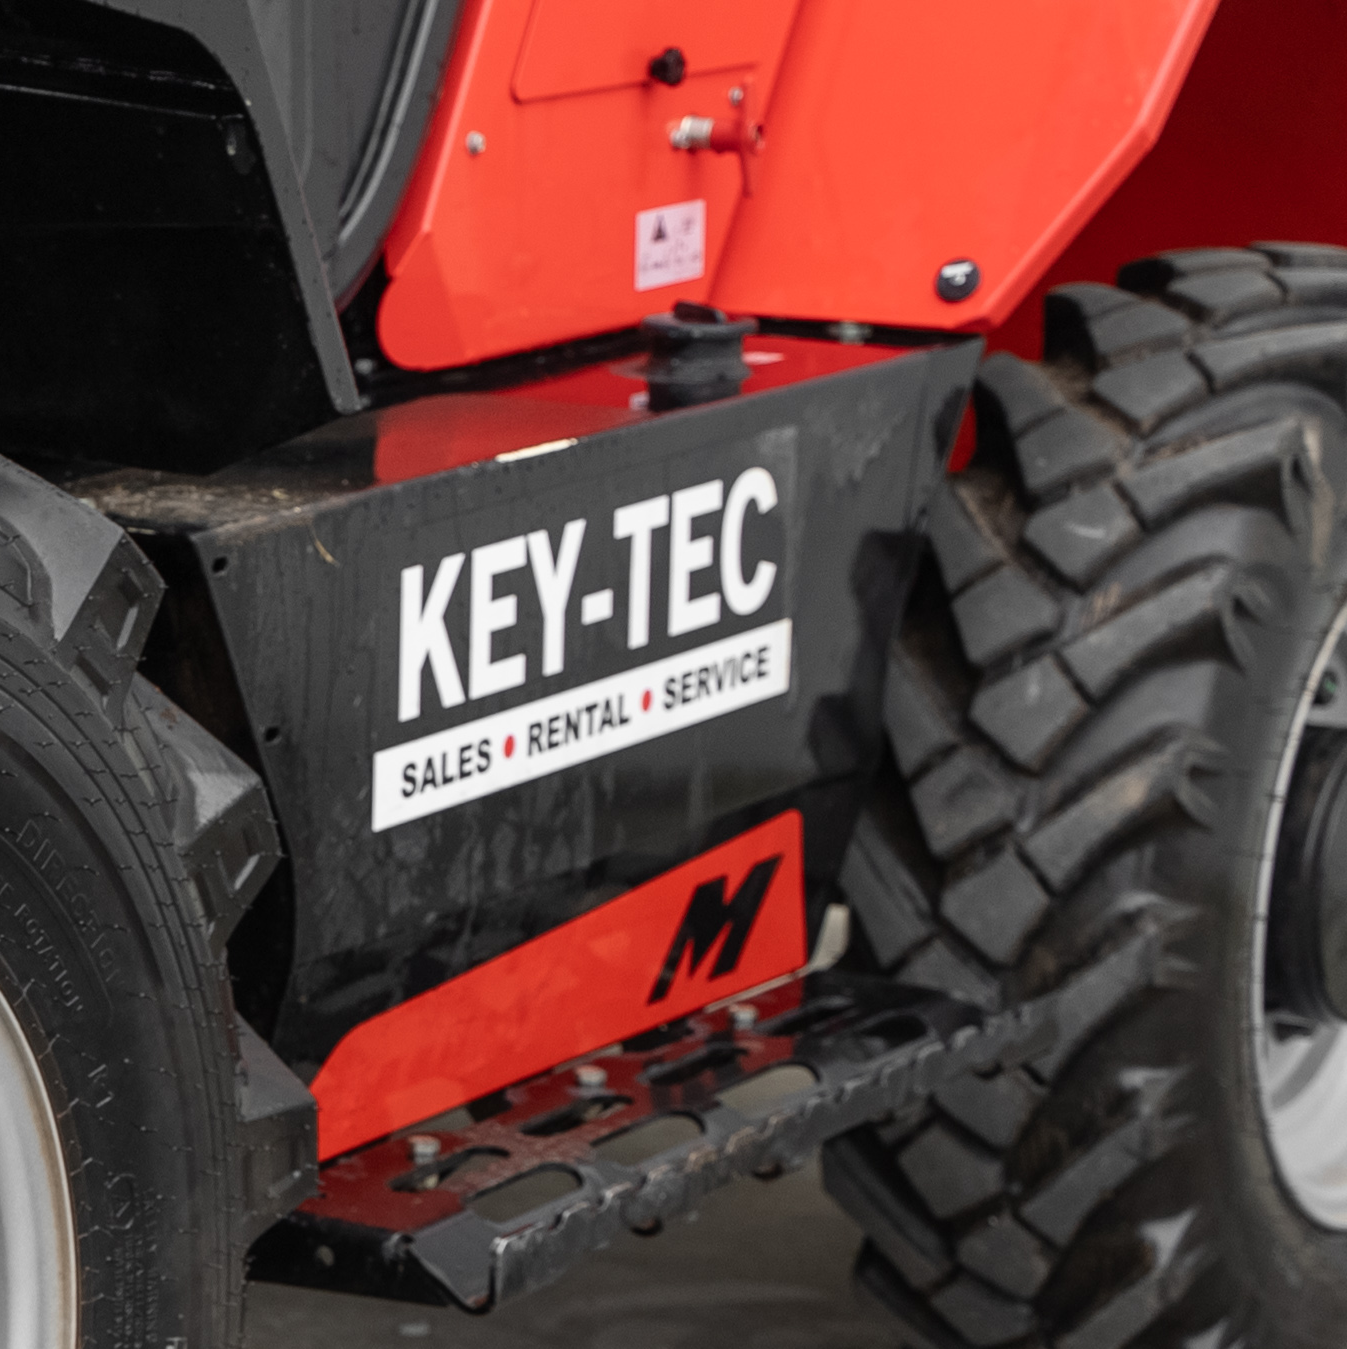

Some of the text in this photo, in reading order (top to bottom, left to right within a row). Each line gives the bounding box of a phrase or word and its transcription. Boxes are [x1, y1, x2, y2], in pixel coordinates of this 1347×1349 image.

[398, 467, 779, 722] KEY-TEC
[401, 646, 771, 799] SALES RENTAL SERVICE
